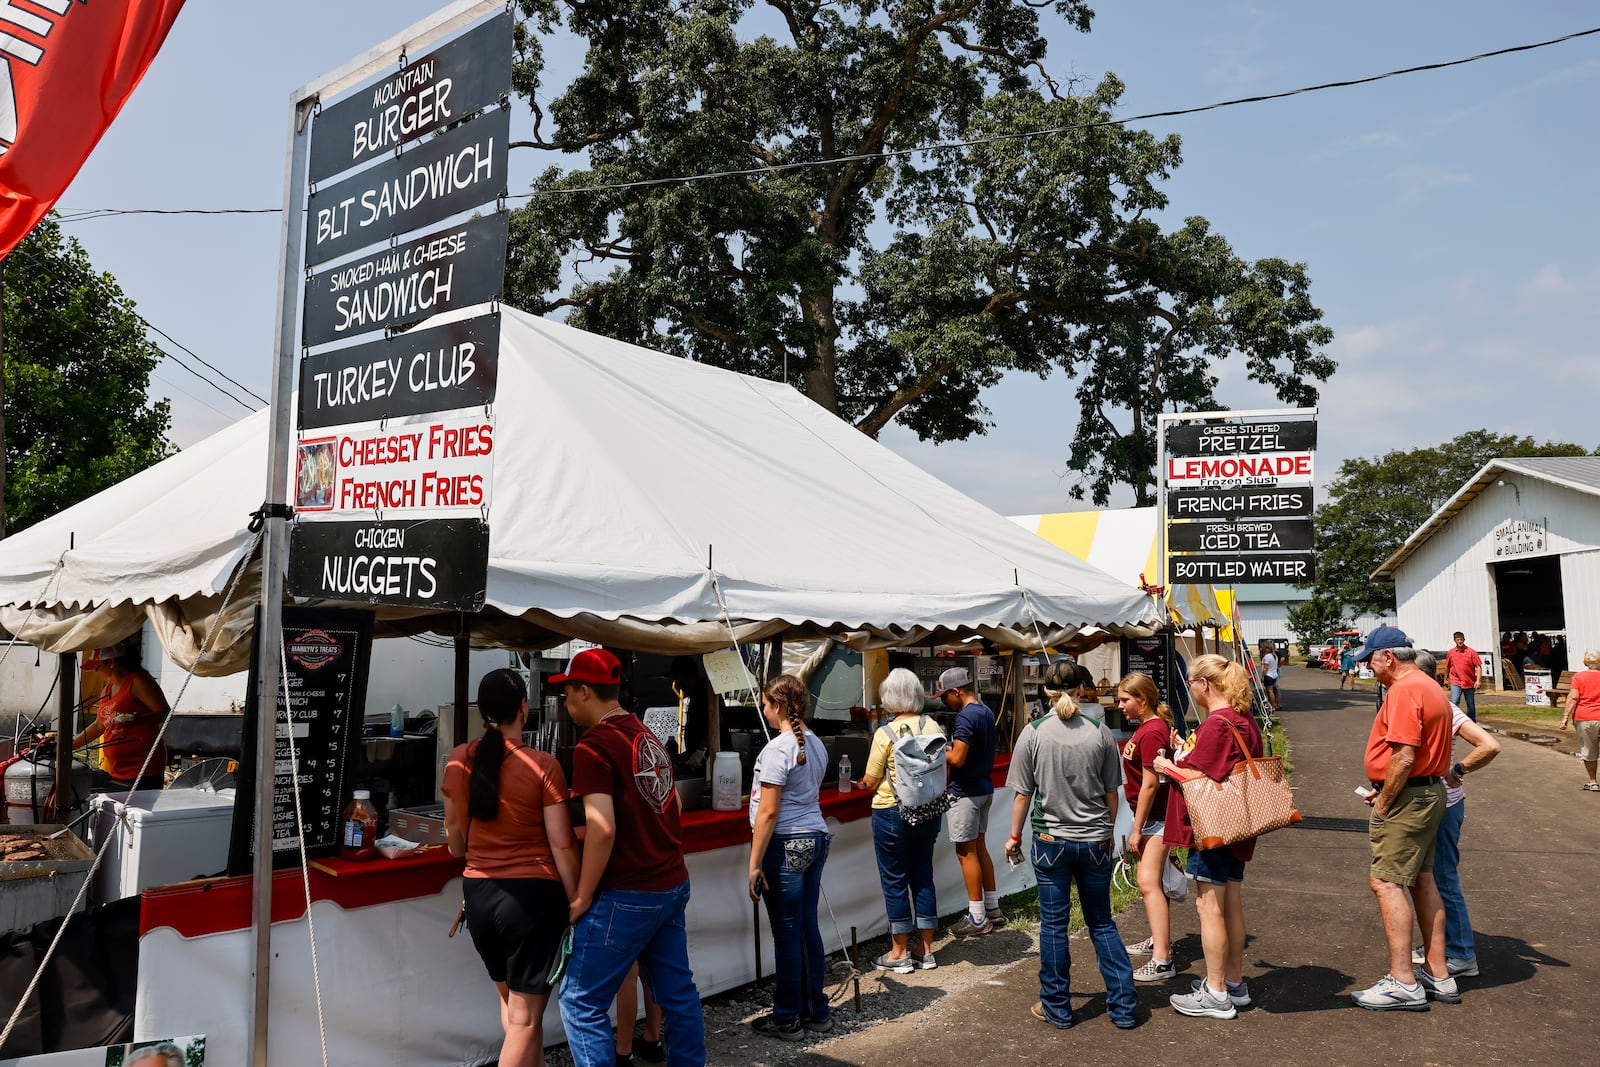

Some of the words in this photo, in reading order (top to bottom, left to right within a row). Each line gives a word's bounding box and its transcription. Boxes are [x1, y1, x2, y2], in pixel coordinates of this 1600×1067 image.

[373, 60, 434, 109] MOUNTAIN
[353, 78, 452, 160] BURGER
[316, 197, 356, 246] BLT
[360, 137, 494, 227] SANDWICH
[330, 261, 374, 292] SMOKED
[376, 256, 400, 276] HAM
[402, 250, 410, 270] &
[414, 232, 468, 266] CHEESE
[334, 264, 454, 332] SANDWICH
[314, 357, 402, 409] TURKEY
[408, 342, 476, 393] CLUB
[1204, 426, 1238, 435] CHEESE
[1240, 424, 1280, 434] STUFFED
[339, 432, 423, 468] CHEESEY
[428, 424, 493, 460] FRIES
[1199, 435, 1286, 452] PRETZEL
[1168, 456, 1312, 480] LEMONADE
[1200, 478, 1242, 486] Frozen
[1246, 476, 1279, 485] Slush
[340, 477, 416, 510] FRENCH
[422, 470, 484, 508] FRIES
[1178, 495, 1244, 512] FRENCH
[1250, 494, 1303, 511] FRIES
[1206, 524, 1235, 532] FRESH
[1237, 522, 1272, 532] BREWED
[1496, 525, 1516, 541] SMALL
[1518, 522, 1542, 534] ANIMAL
[355, 528, 405, 549] CHICKEN
[1200, 534, 1240, 550] ICED
[1245, 532, 1280, 548] TEA
[1505, 542, 1534, 555] BUILDING
[322, 555, 437, 598] NUGGETS
[1176, 562, 1246, 578] BOTTLED
[1250, 560, 1306, 577] WATER
[338, 674, 346, 682] $7
[335, 692, 344, 701] $7
[299, 710, 318, 718] CLUB
[334, 710, 342, 718] $7
[332, 725, 340, 734] $7
[329, 742, 338, 751] $5
[327, 759, 335, 768] $5
[326, 773, 334, 782] $3
[323, 788, 331, 797] $6
[322, 806, 330, 814] $5
[321, 821, 329, 829] $6
[276, 828, 290, 838] TEA
